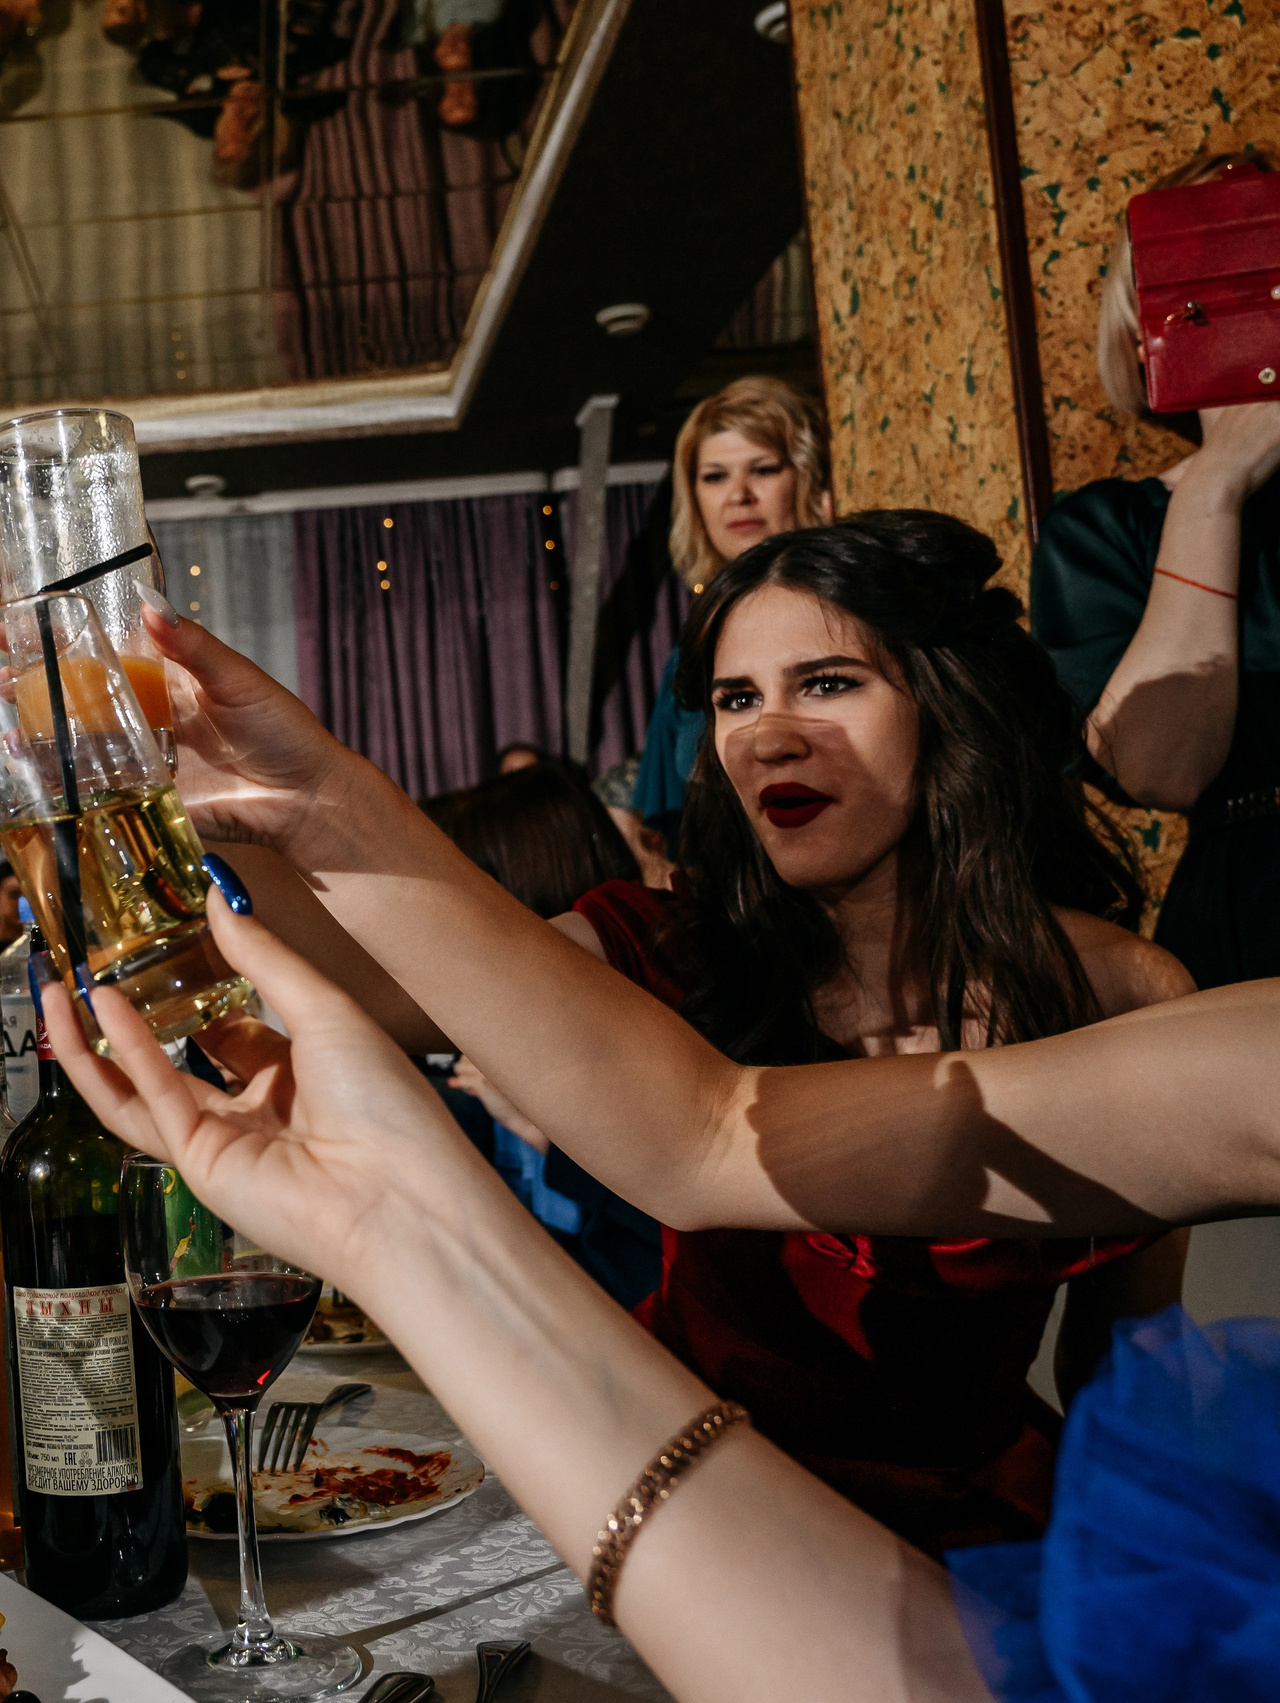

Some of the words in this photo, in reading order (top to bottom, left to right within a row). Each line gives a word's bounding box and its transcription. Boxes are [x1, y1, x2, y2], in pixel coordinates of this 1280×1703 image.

[40, 1452, 50, 1461] 750
[59, 1467, 106, 1480] УПОТРЕБЛЕНИЕ
[107, 1462, 138, 1476] АЛКОГОЛЯ
[53, 1478, 89, 1491] ВАШЕМУ
[91, 1473, 139, 1491] ЗДОРОВЬЮ
